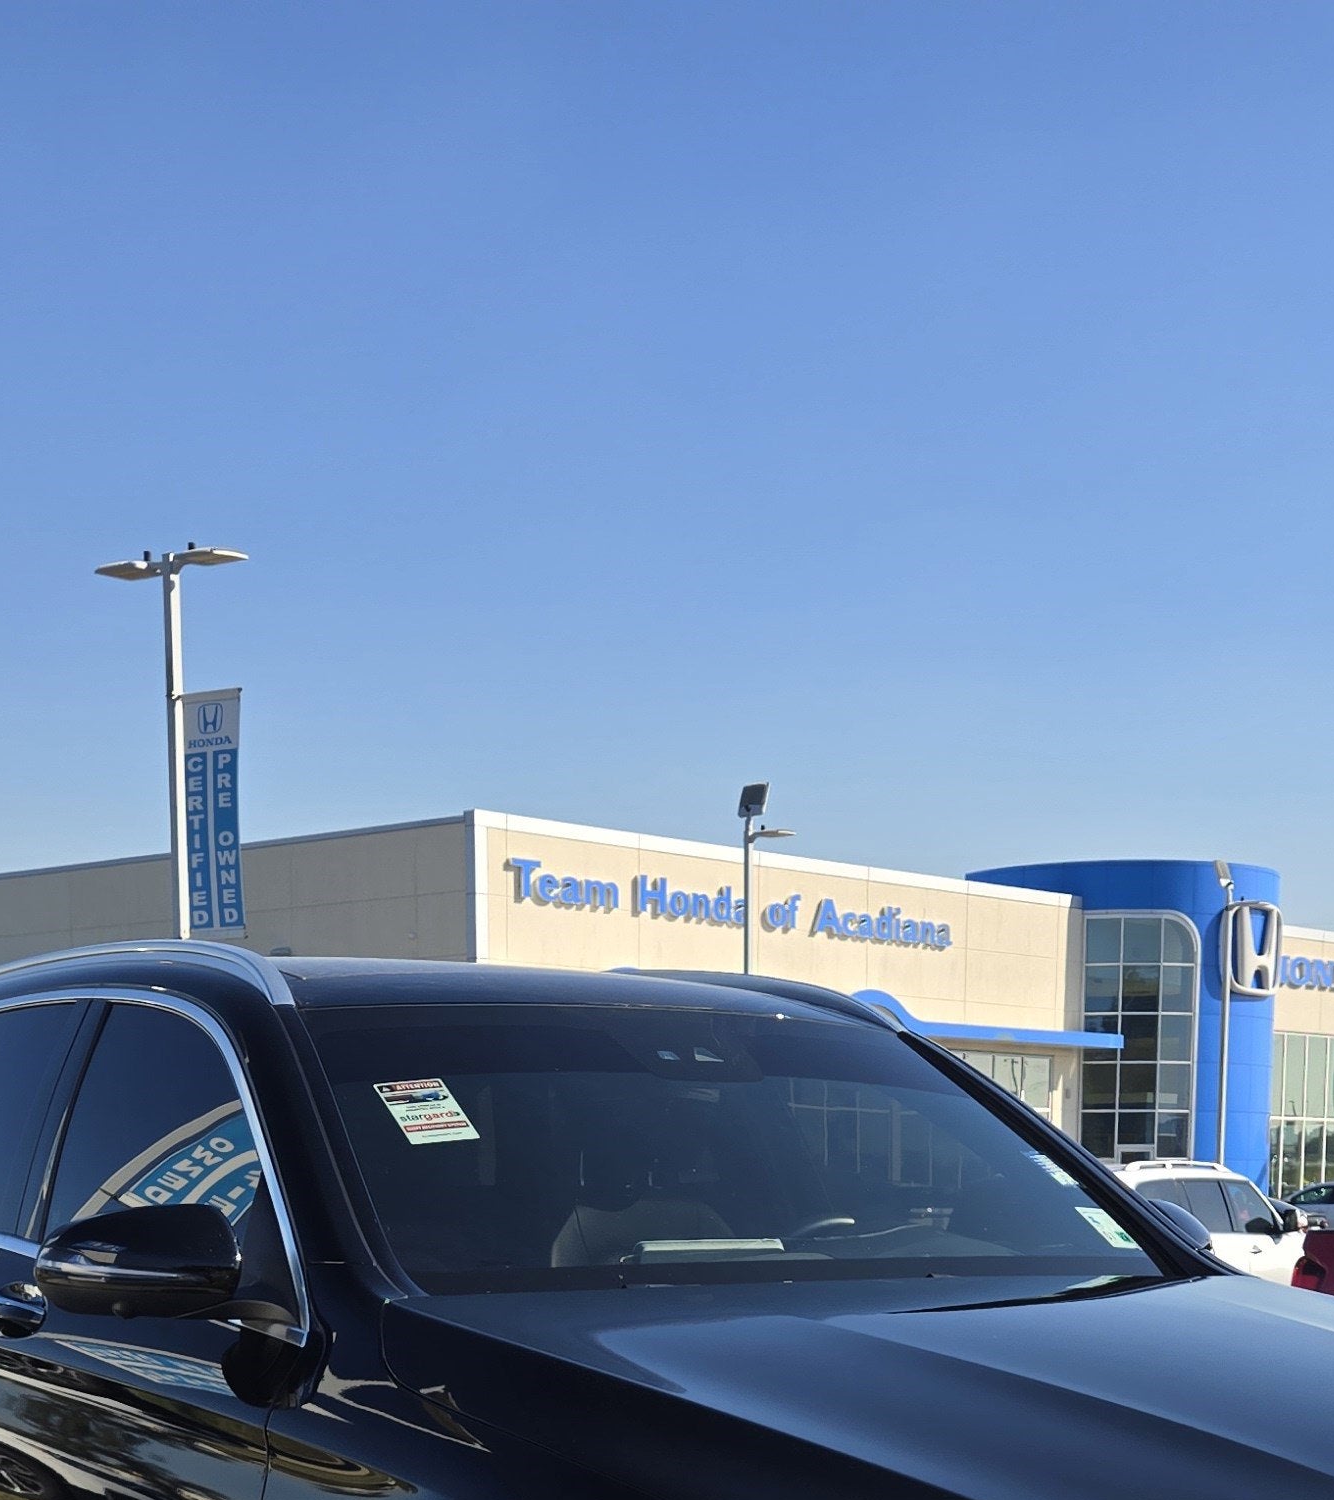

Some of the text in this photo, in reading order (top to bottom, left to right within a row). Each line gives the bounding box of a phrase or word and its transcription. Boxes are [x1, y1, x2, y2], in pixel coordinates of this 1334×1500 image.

[188, 735, 232, 748] HONDA
[187, 753, 209, 926] CERTIFIED
[217, 753, 239, 924] PRE OWNED
[511, 858, 619, 909] Team
[767, 893, 802, 930] of
[816, 897, 952, 949] Acadiana
